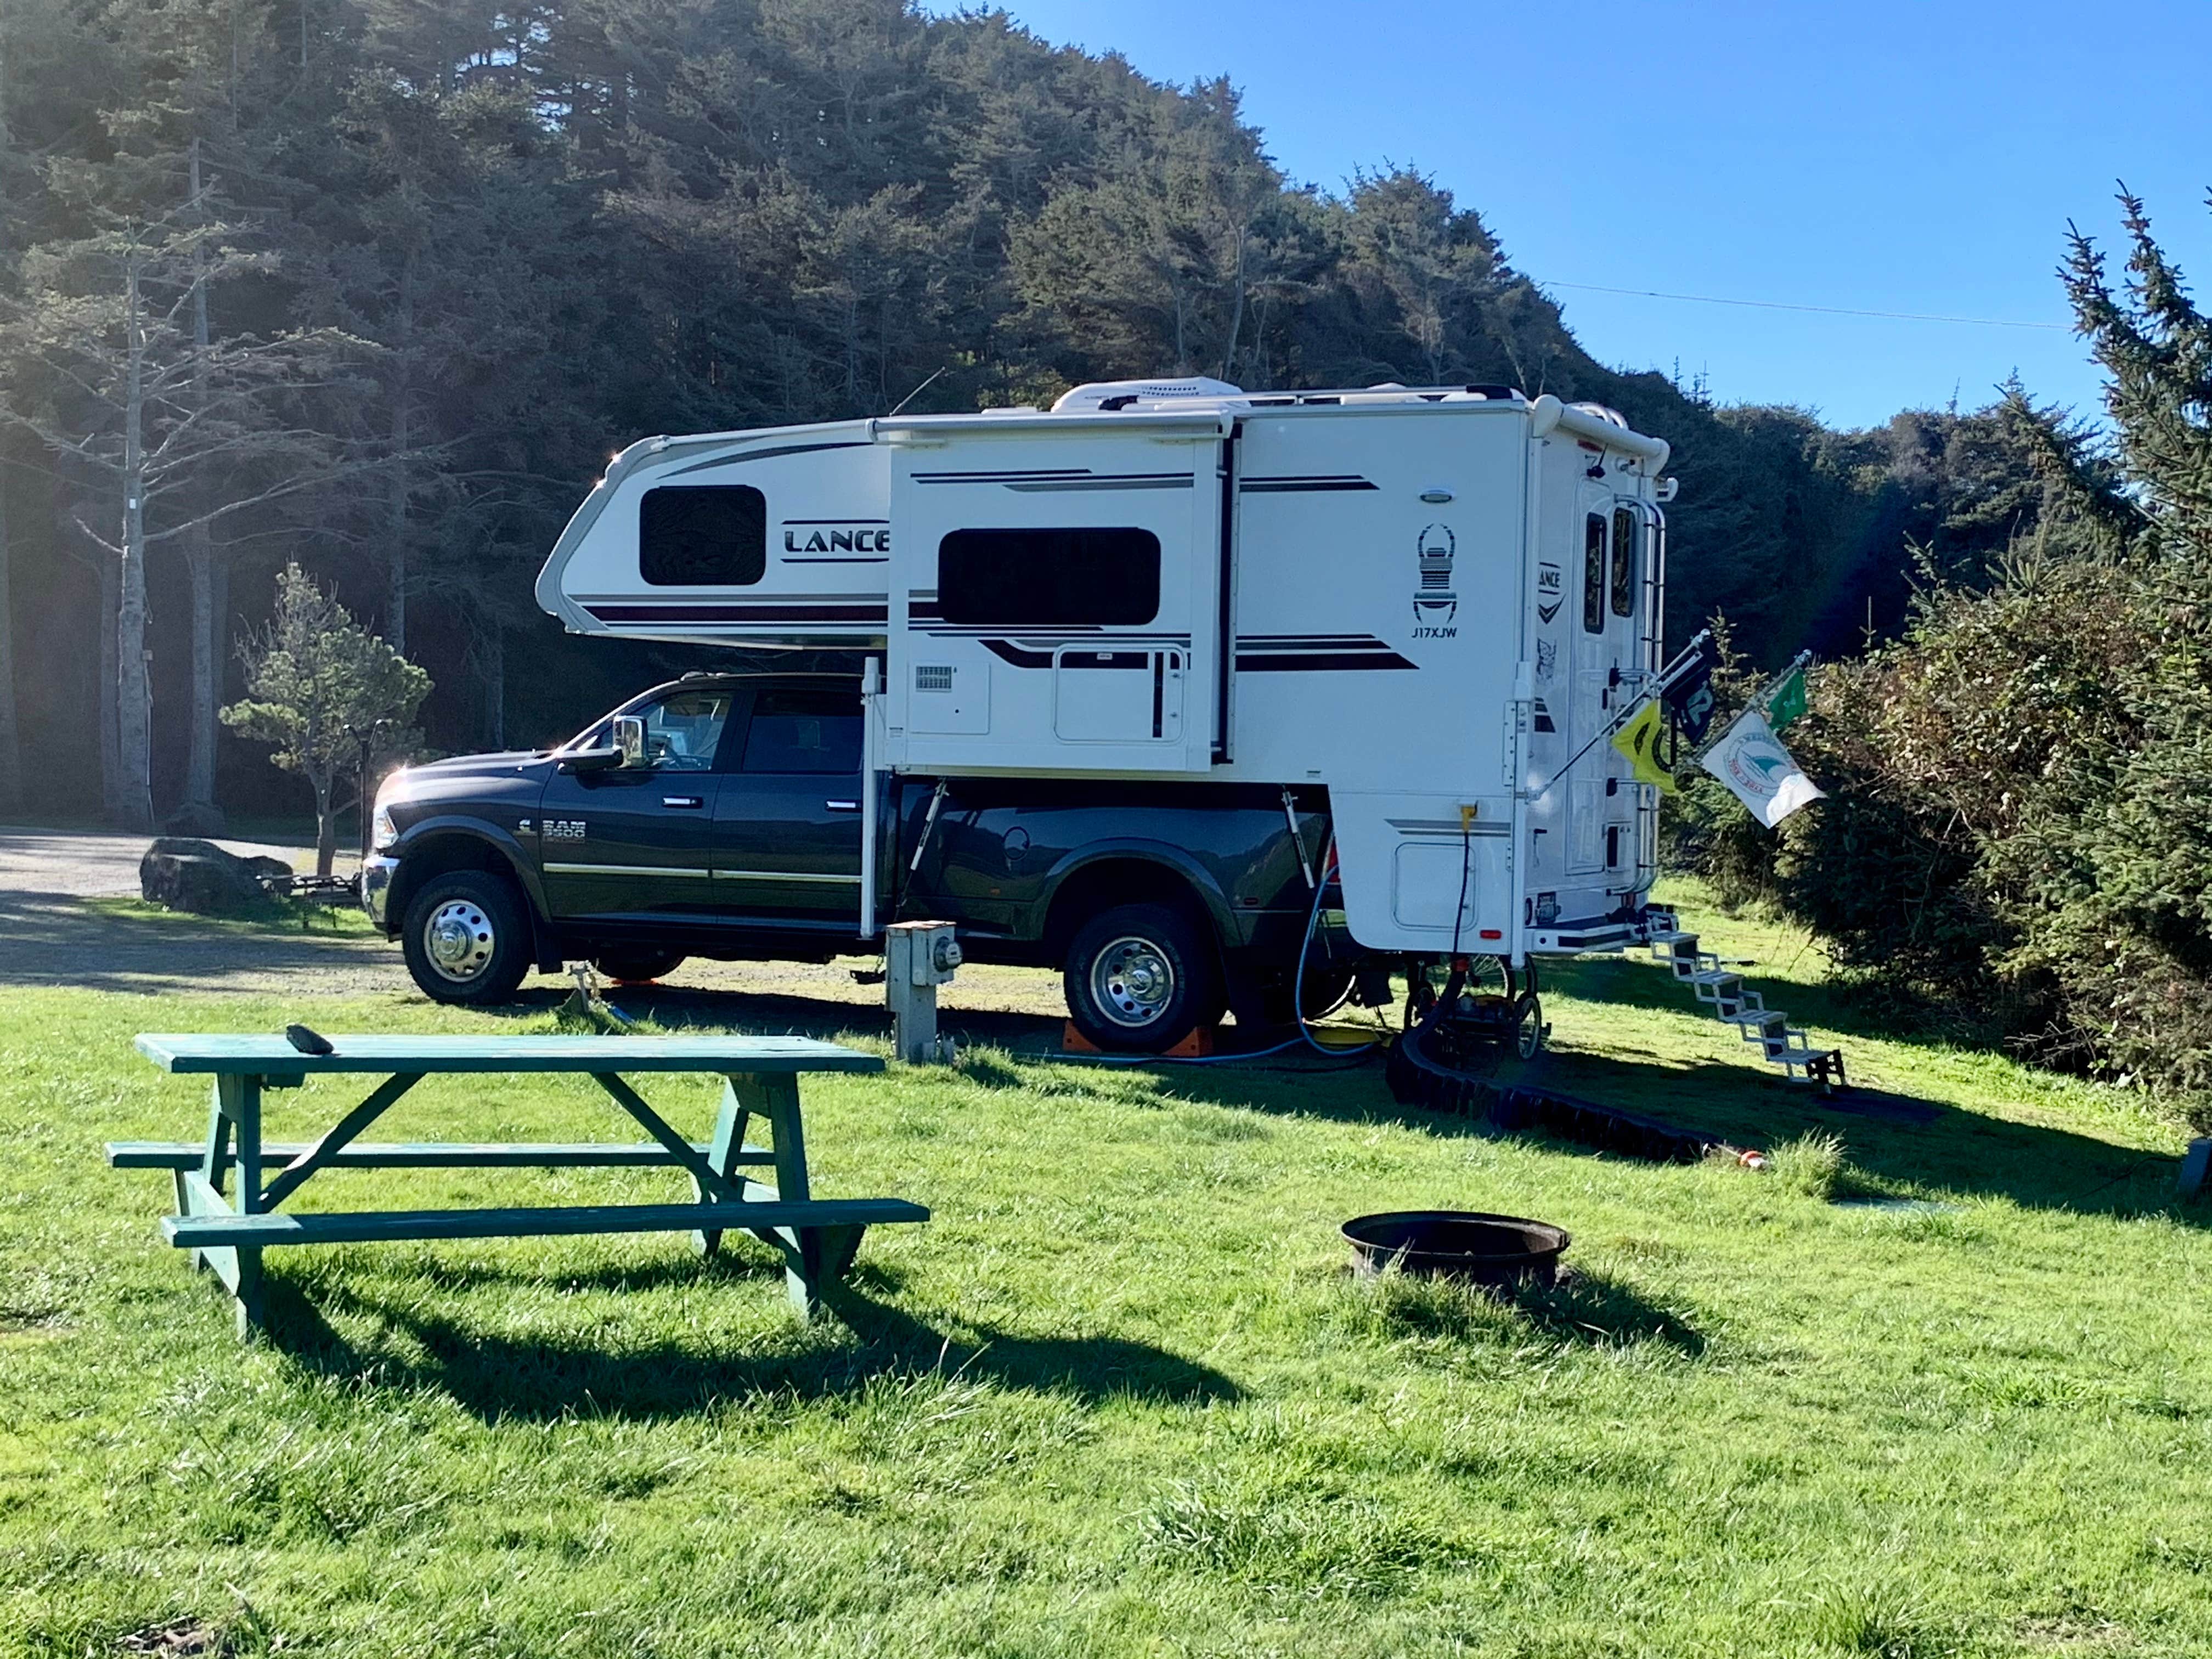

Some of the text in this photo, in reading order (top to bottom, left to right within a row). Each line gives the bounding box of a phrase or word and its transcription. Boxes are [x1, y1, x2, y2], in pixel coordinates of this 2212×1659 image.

[785, 531, 890, 552] LANCE
[1538, 570, 1560, 588] ANCE
[1412, 627, 1457, 638] J17XJW
[543, 820, 586, 830] RAM
